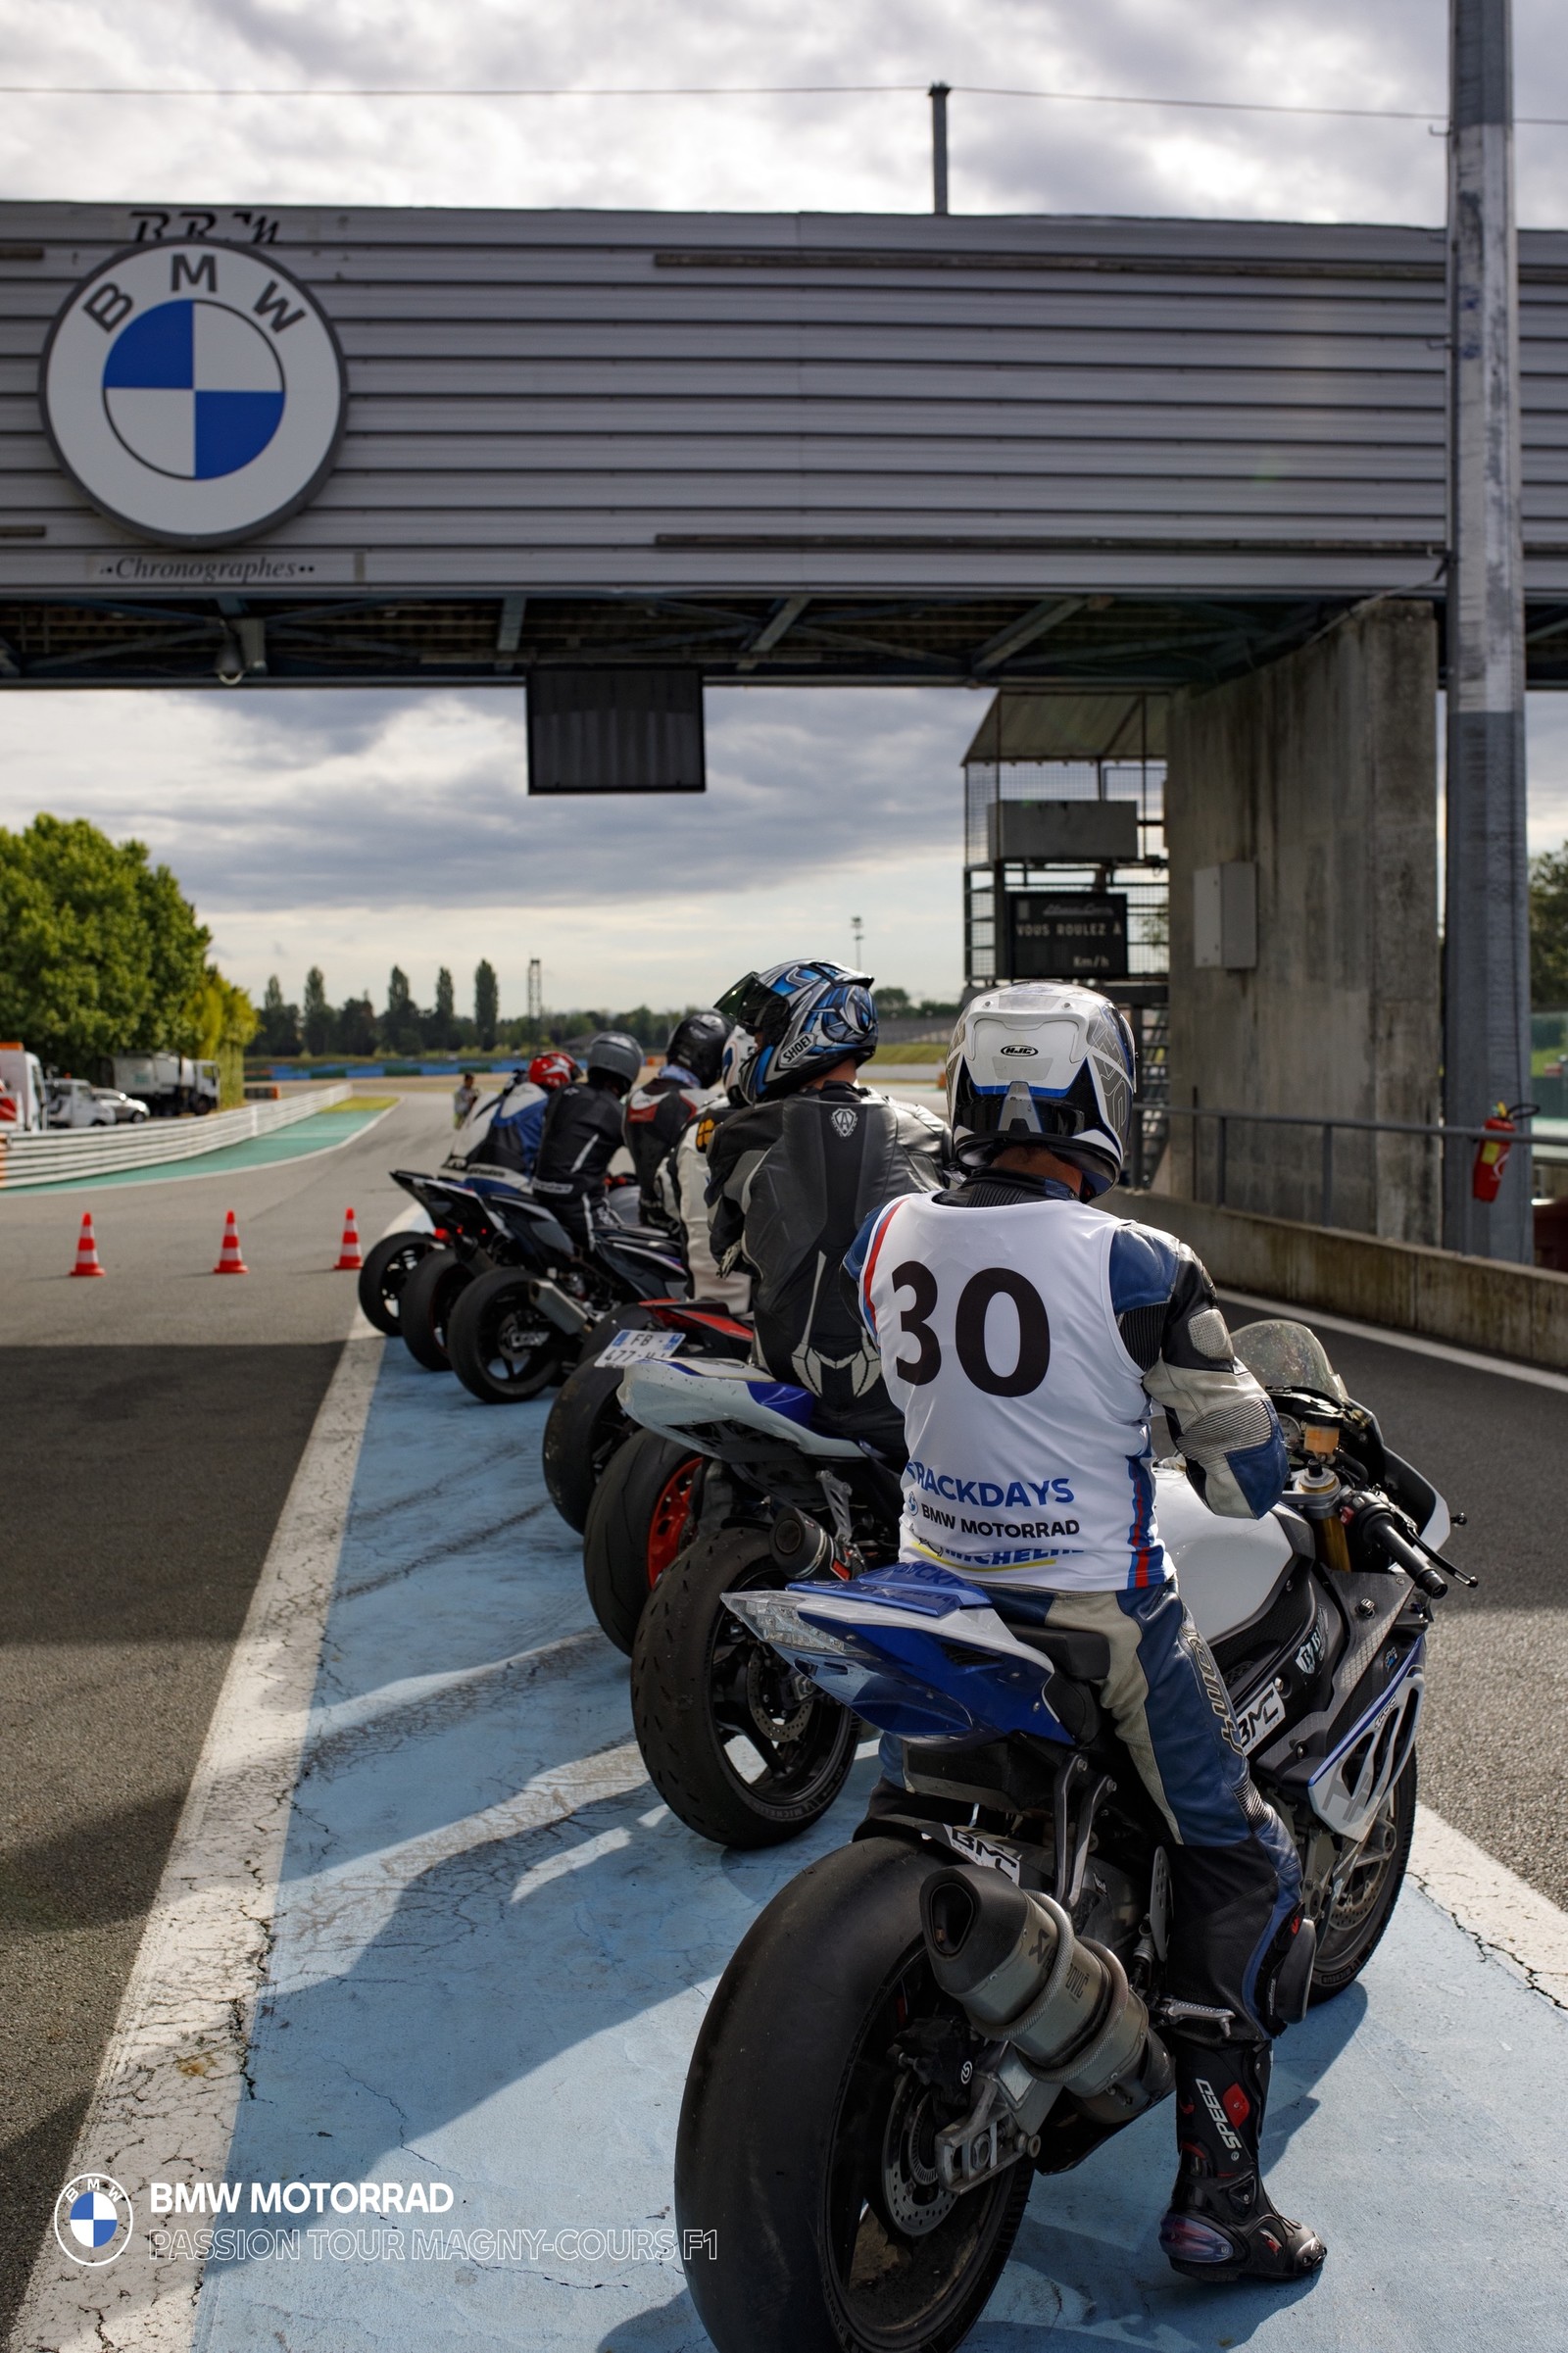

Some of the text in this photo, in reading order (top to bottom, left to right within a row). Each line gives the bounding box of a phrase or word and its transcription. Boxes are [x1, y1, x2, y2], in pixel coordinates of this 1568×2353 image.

[82, 253, 308, 334] BMW
[116, 557, 297, 585] Chronographes
[1015, 923, 1051, 937] VOUS
[1055, 923, 1106, 937] ROULEZ
[783, 1035, 812, 1063] SHOEI
[892, 1260, 1052, 1398] 30
[921, 1503, 1081, 1540] BMW MOTORRAD
[1195, 2078, 1243, 2149] SPEED
